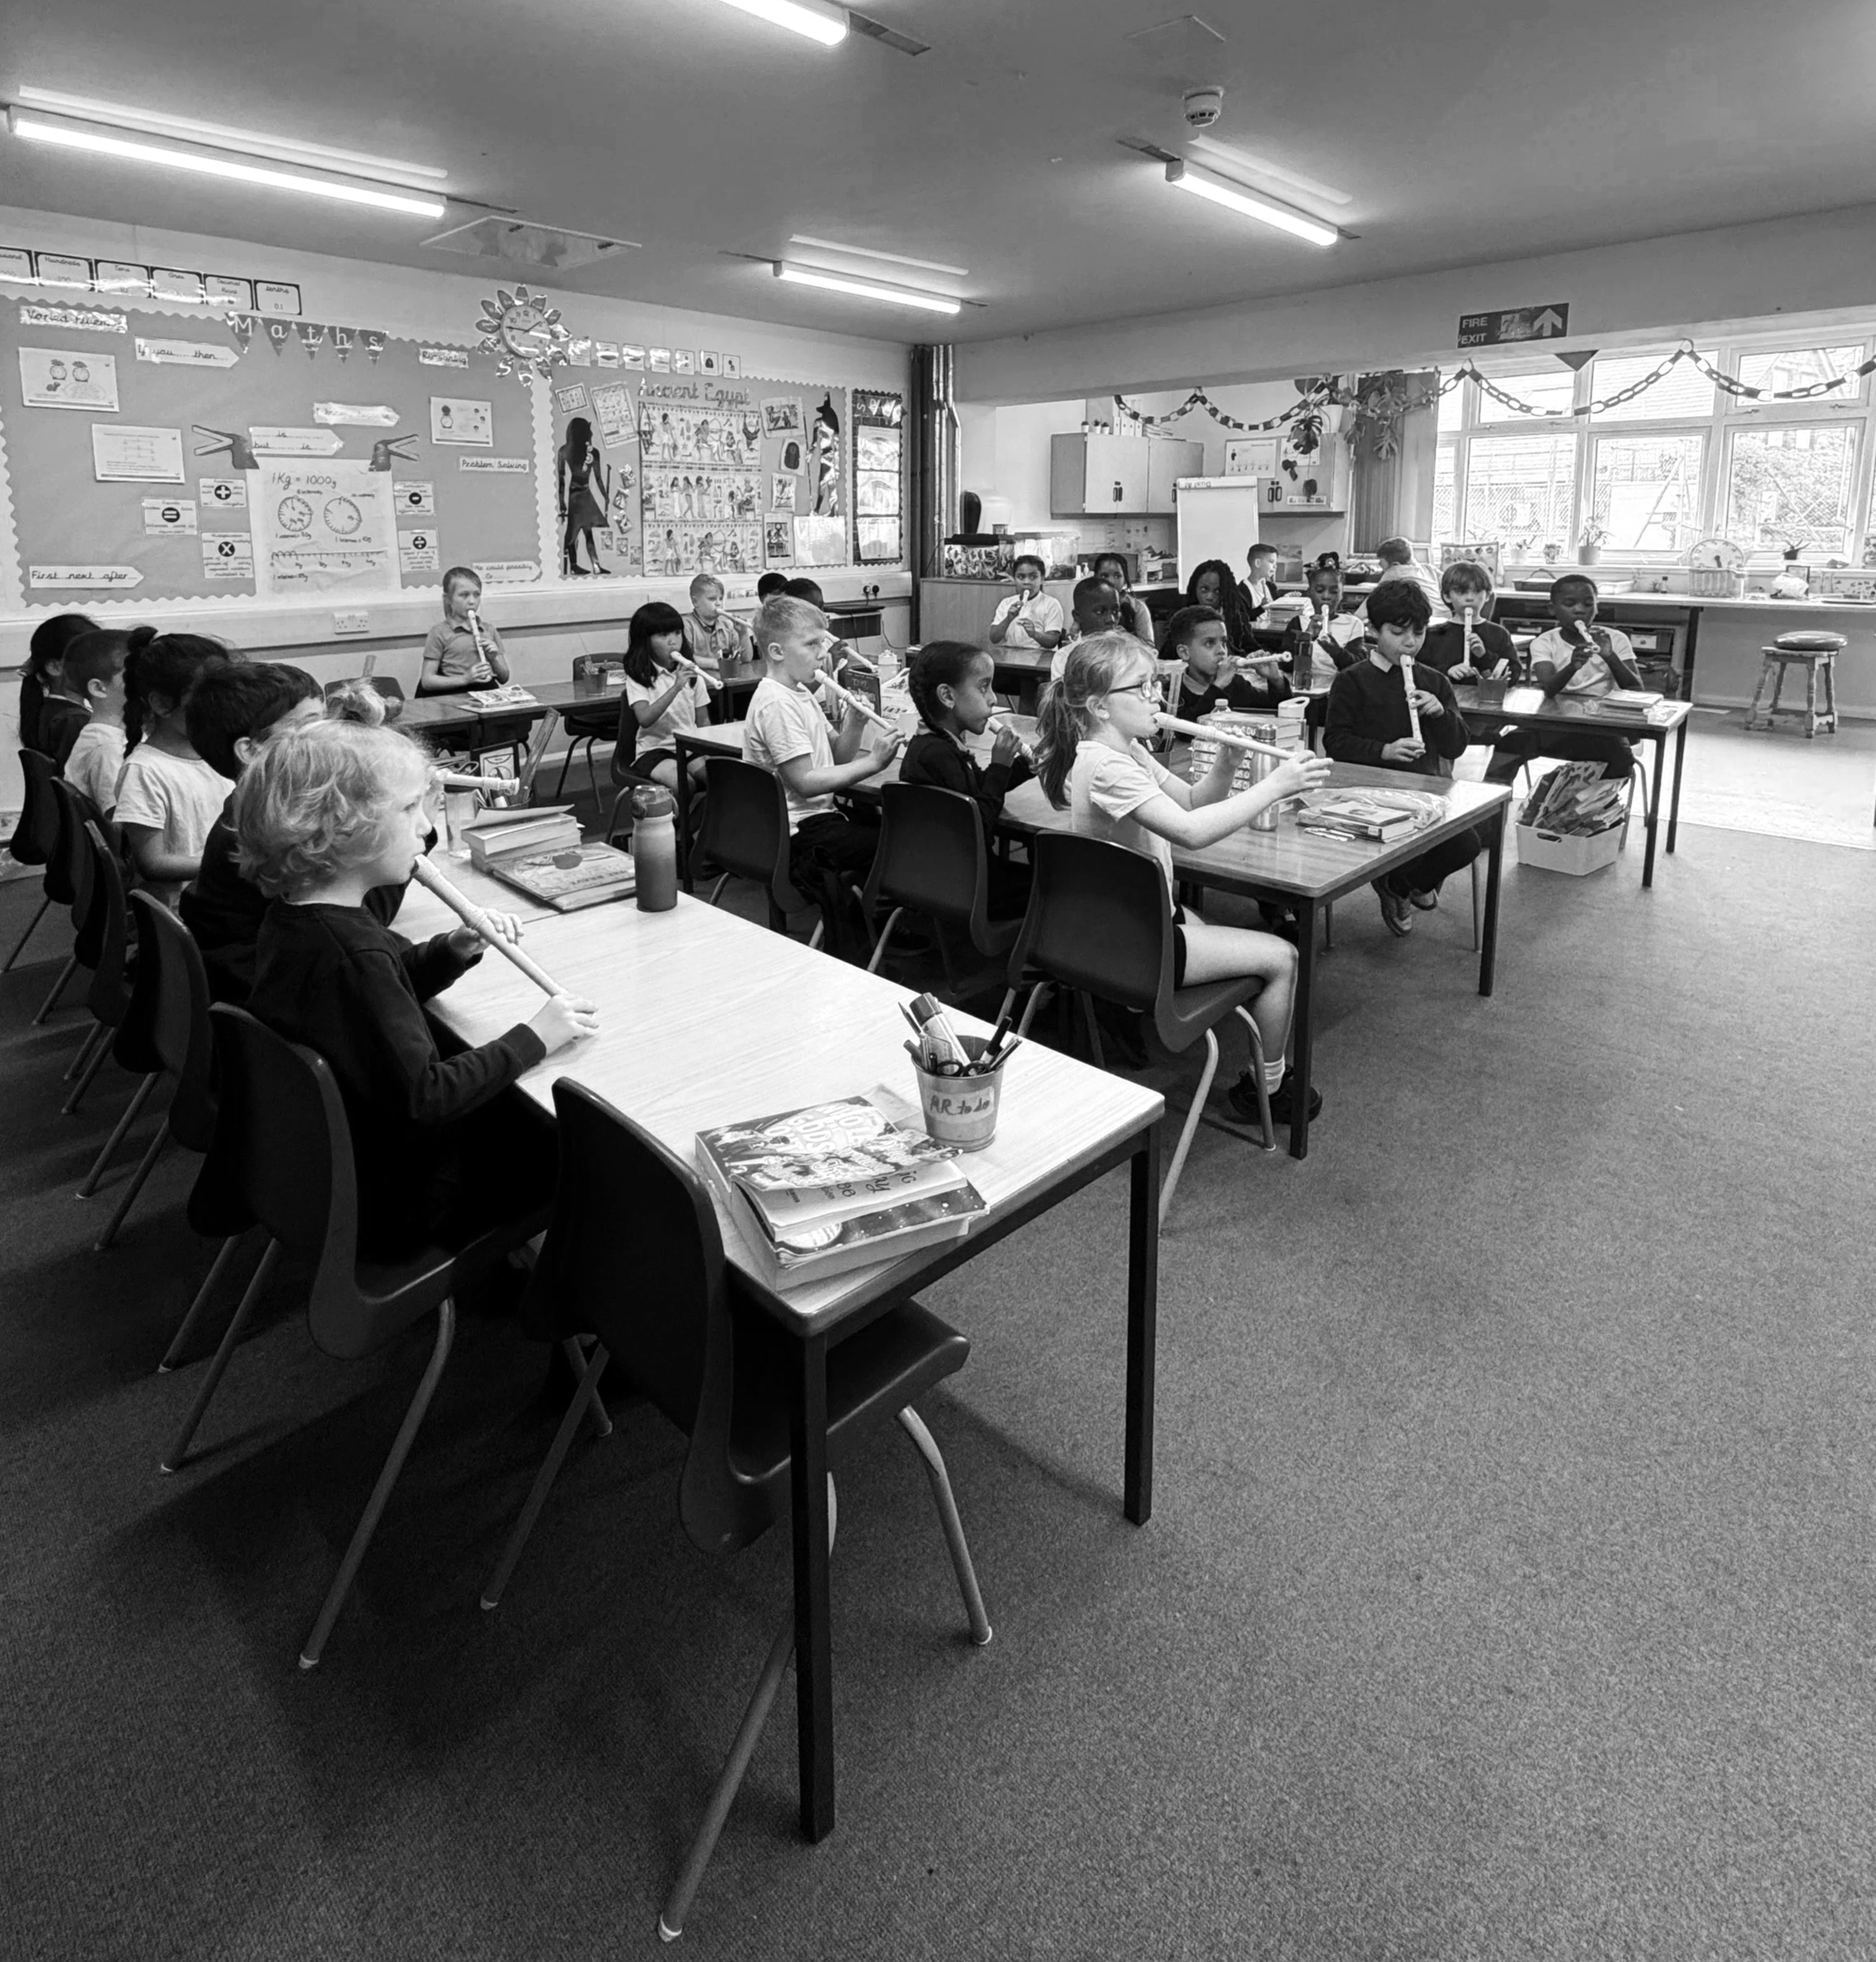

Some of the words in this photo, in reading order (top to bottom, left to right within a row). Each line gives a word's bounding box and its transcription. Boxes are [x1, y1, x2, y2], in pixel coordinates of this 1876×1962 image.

[1462, 317, 1488, 329] FIRE
[1460, 333, 1486, 345] EXIT
[194, 350, 217, 359] then
[637, 377, 699, 399] Ancient
[705, 382, 751, 408] Egypt
[462, 459, 493, 468] Problem
[497, 461, 527, 471] Solving
[306, 475, 336, 489] 1000g
[32, 570, 59, 579] First
[102, 571, 128, 582] after
[930, 1094, 953, 1115] AR
[957, 1100, 972, 1115] to
[787, 1114, 836, 1154] GODS
